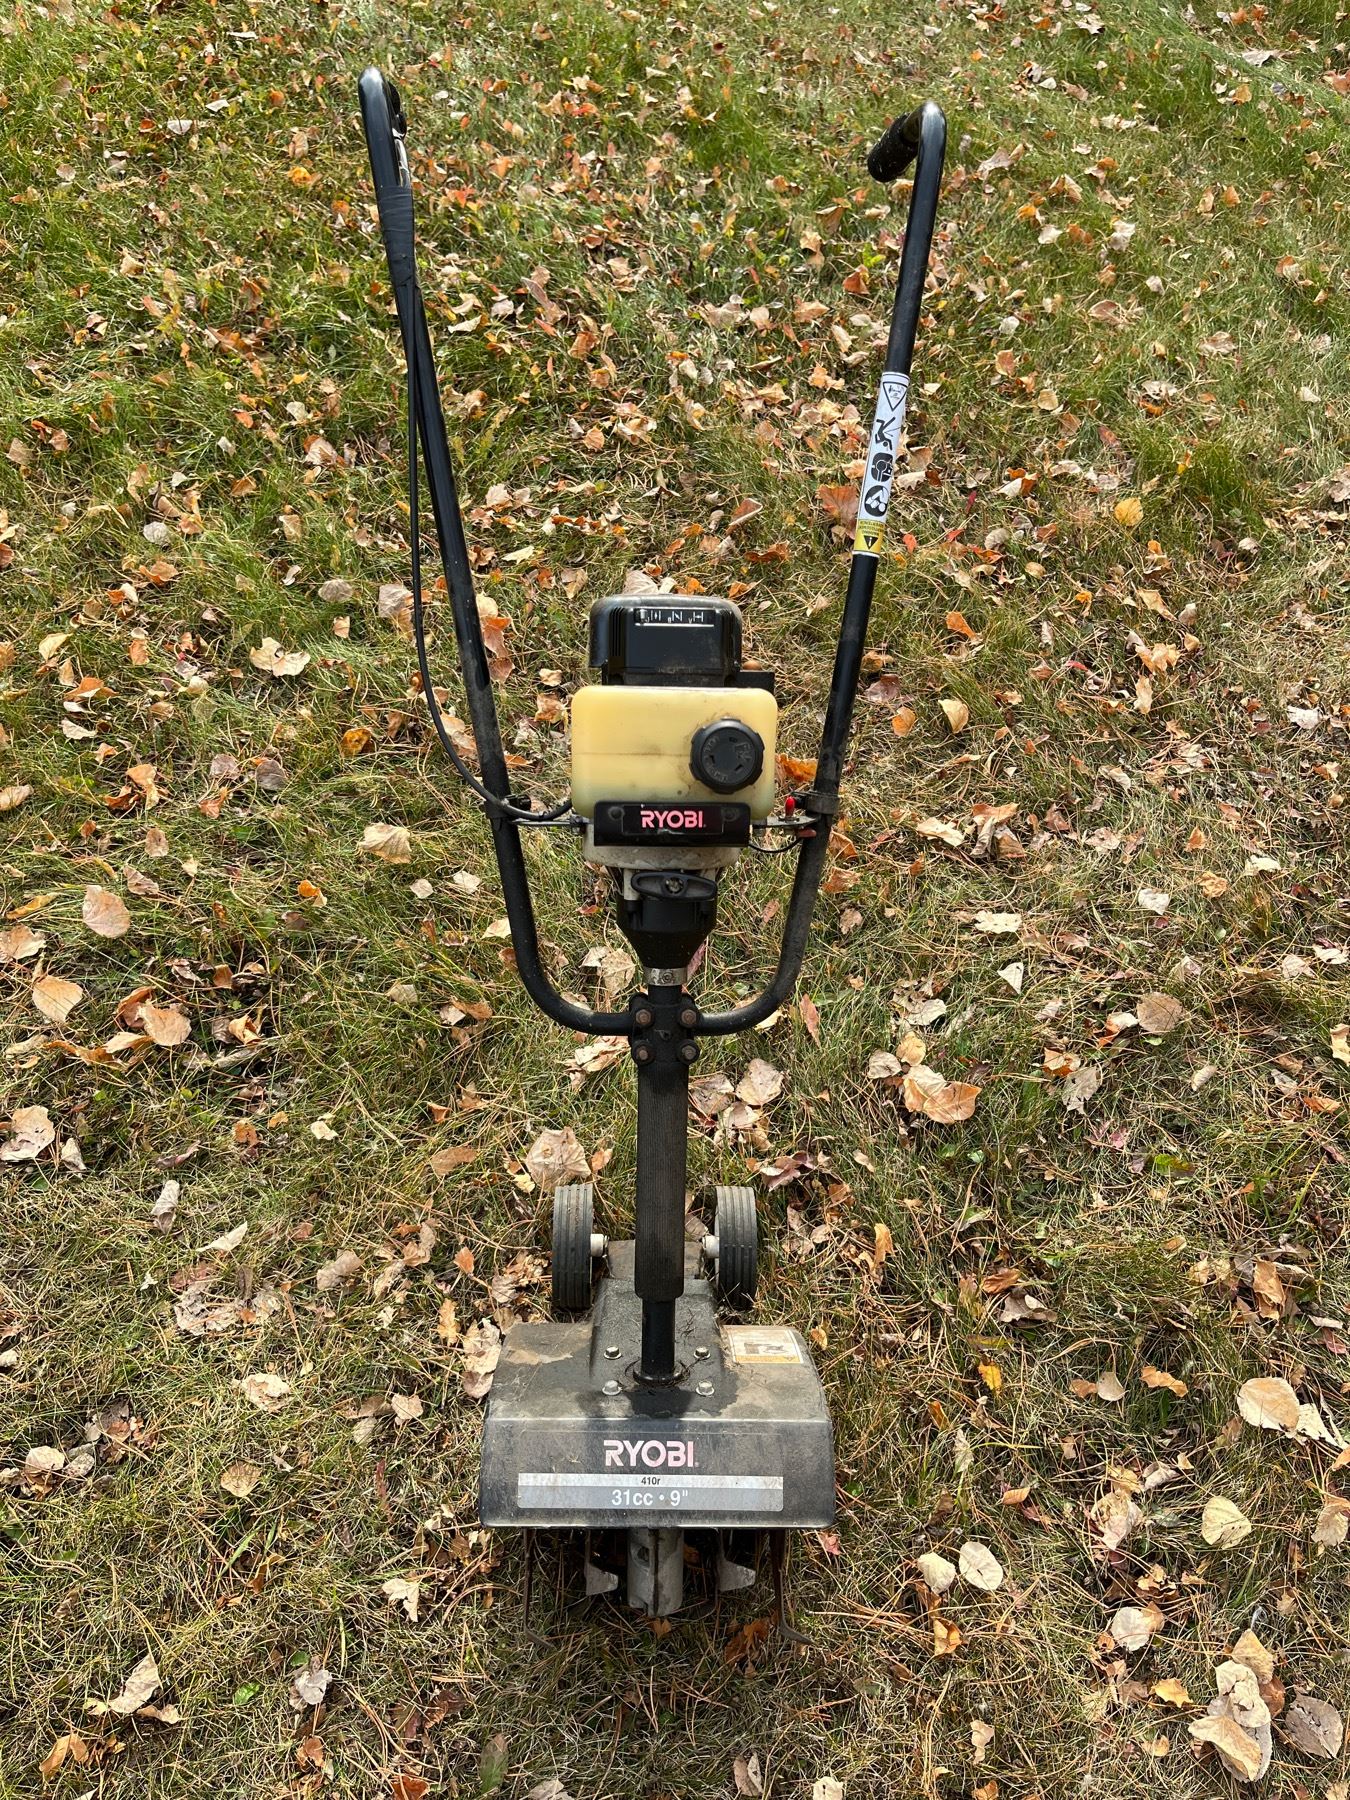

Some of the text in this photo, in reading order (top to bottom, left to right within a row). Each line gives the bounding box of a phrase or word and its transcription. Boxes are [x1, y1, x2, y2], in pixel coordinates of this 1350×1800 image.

[640, 810, 704, 828] RYOBI
[603, 1440, 694, 1467] RYOBI
[640, 1477, 660, 1485] 410r
[611, 1489, 688, 1506] 31cc 9"
